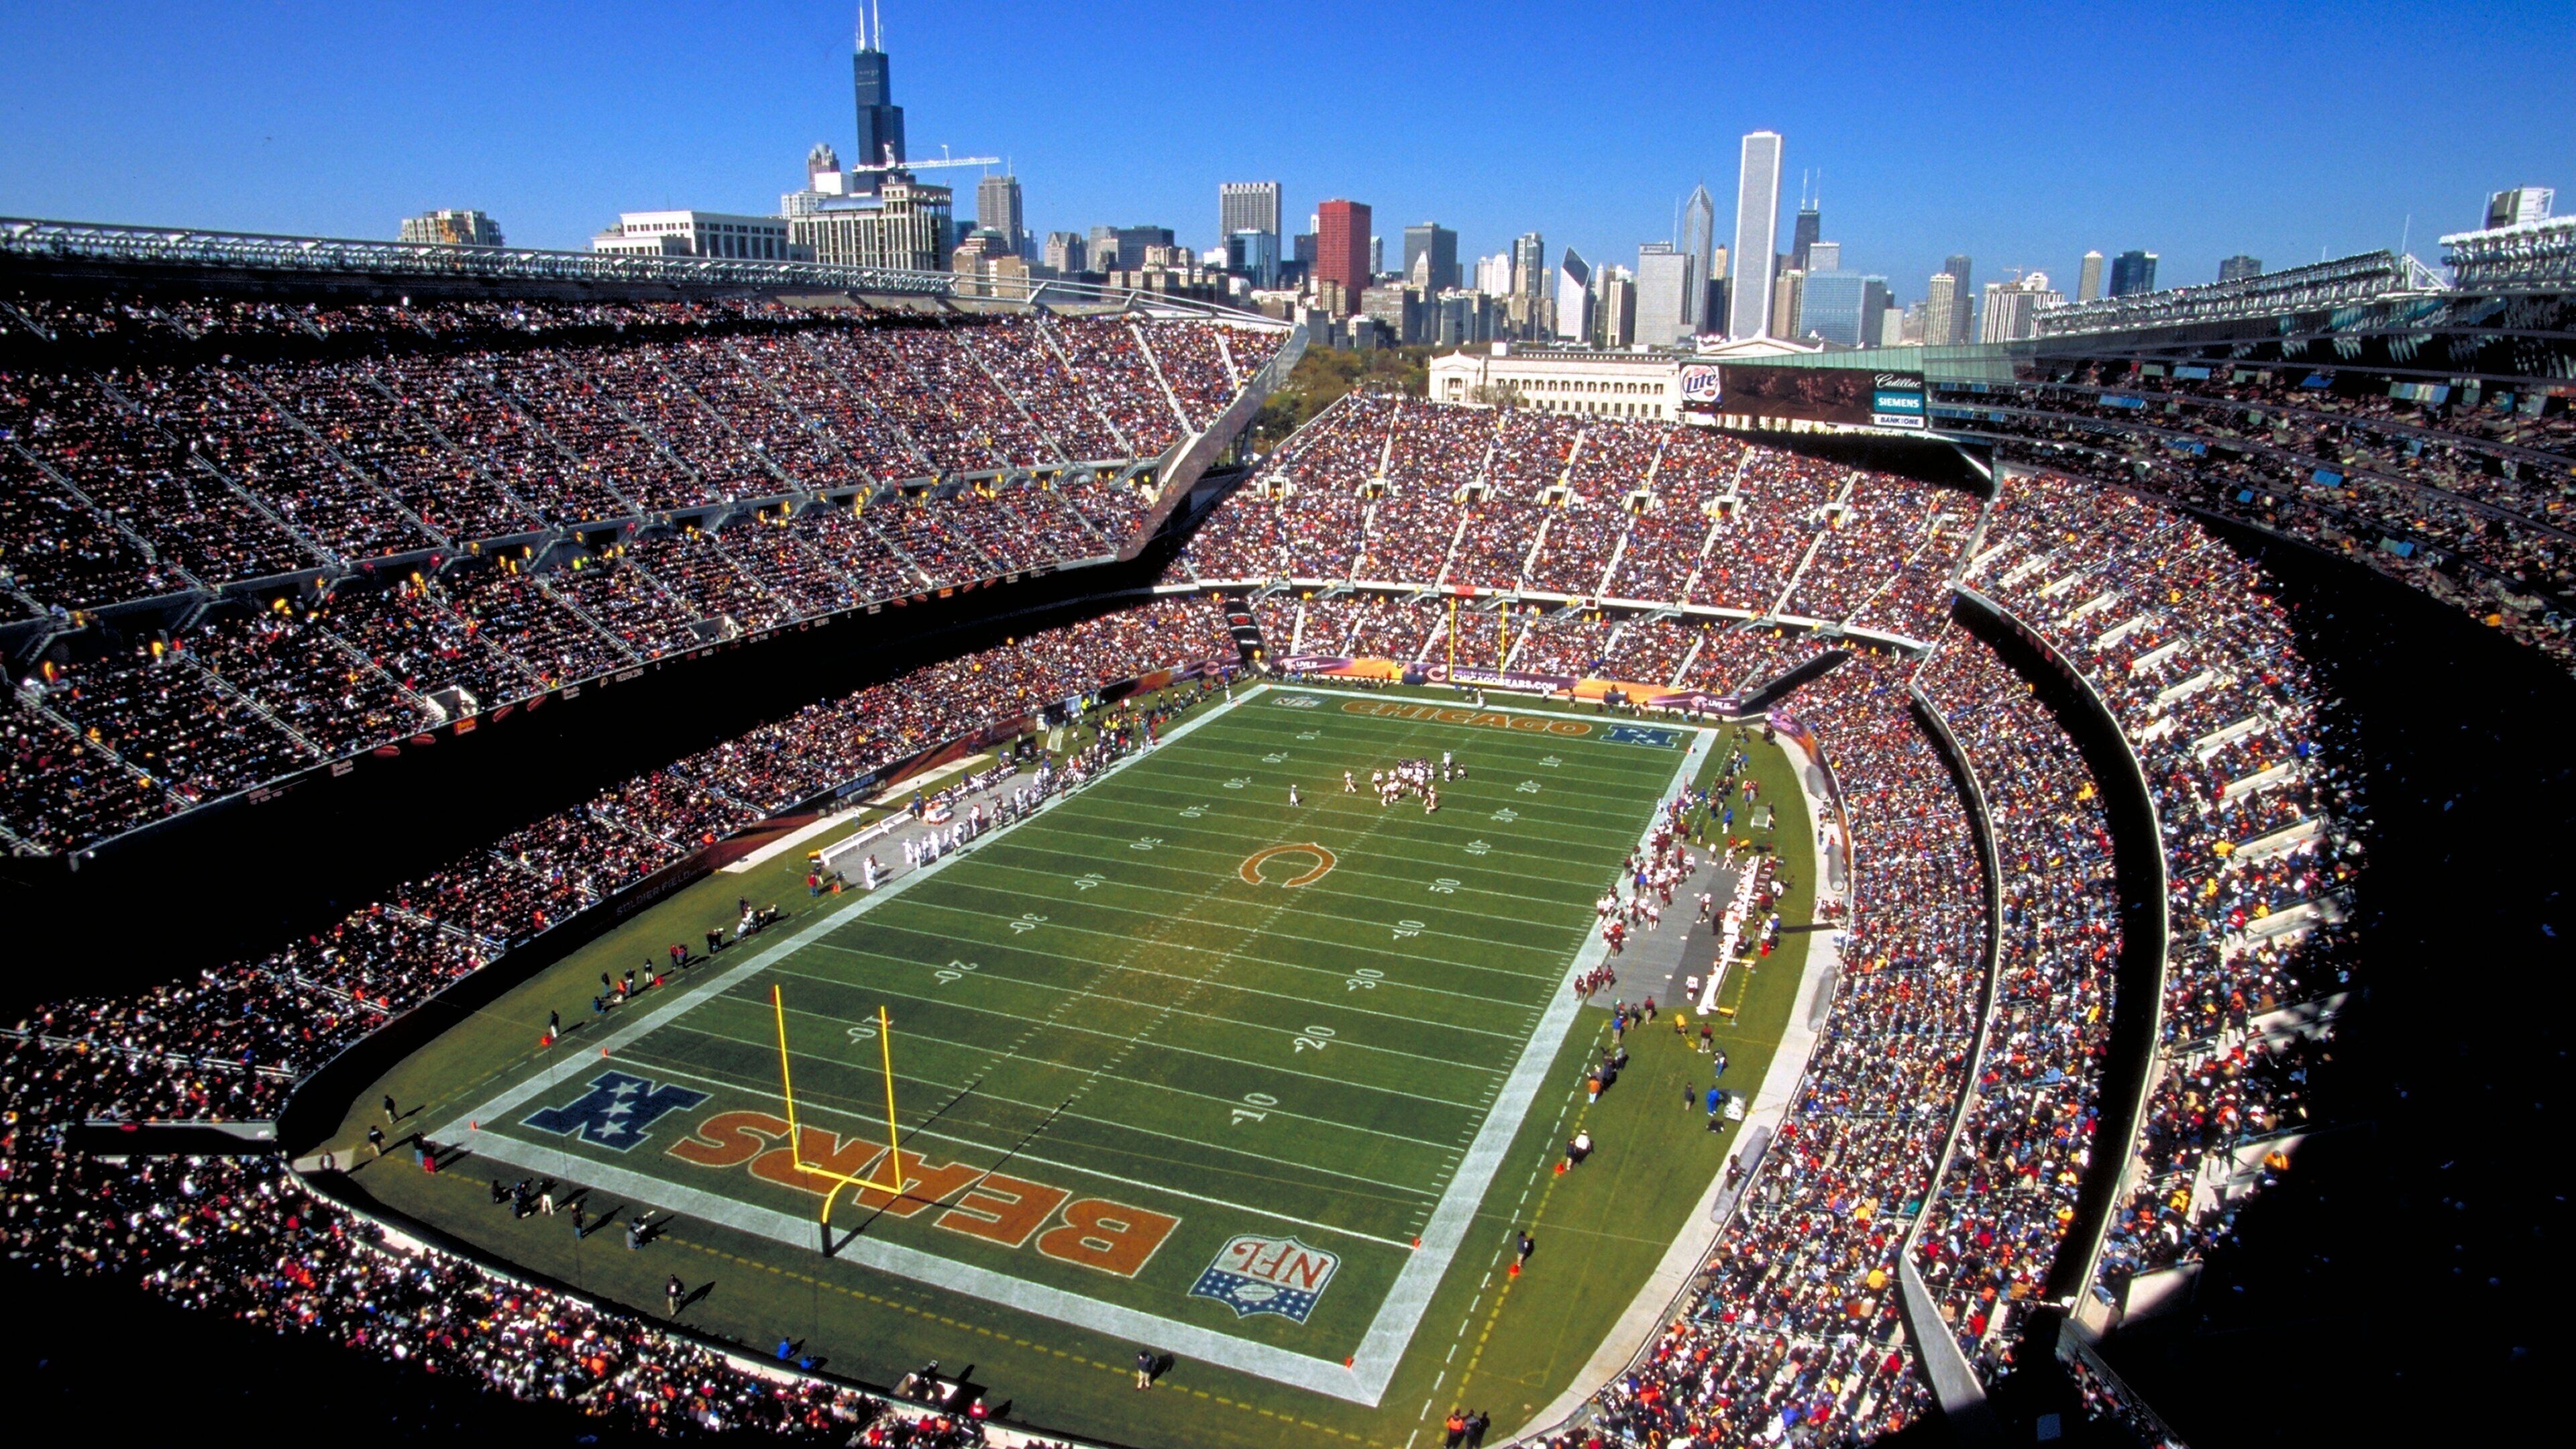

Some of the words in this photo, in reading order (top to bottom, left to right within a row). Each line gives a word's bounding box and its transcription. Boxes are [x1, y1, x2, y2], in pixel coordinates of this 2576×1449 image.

[1686, 374, 1717, 393] Lite
[1875, 374, 1921, 388] Cadillac
[1878, 397, 1919, 409] SIEMENS
[616, 667, 644, 682] REDSKINS
[1452, 674, 1557, 691] CHICAGOBEARS.COM
[1341, 700, 1593, 736] CHICAGO
[1075, 873, 1106, 887] 40
[1430, 878, 1461, 894] 50
[615, 886, 659, 916] SOLDIER
[661, 870, 690, 891] FIELD
[1010, 913, 1048, 930] 30
[1393, 920, 1426, 937] 40
[934, 959, 978, 981] 20
[1346, 968, 1384, 989] 30
[847, 1015, 894, 1039] 10
[1294, 1025, 1335, 1051] 20
[1232, 1092, 1278, 1122] 10
[665, 1111, 1183, 1279] BEARS
[1232, 1241, 1330, 1289] NFL
